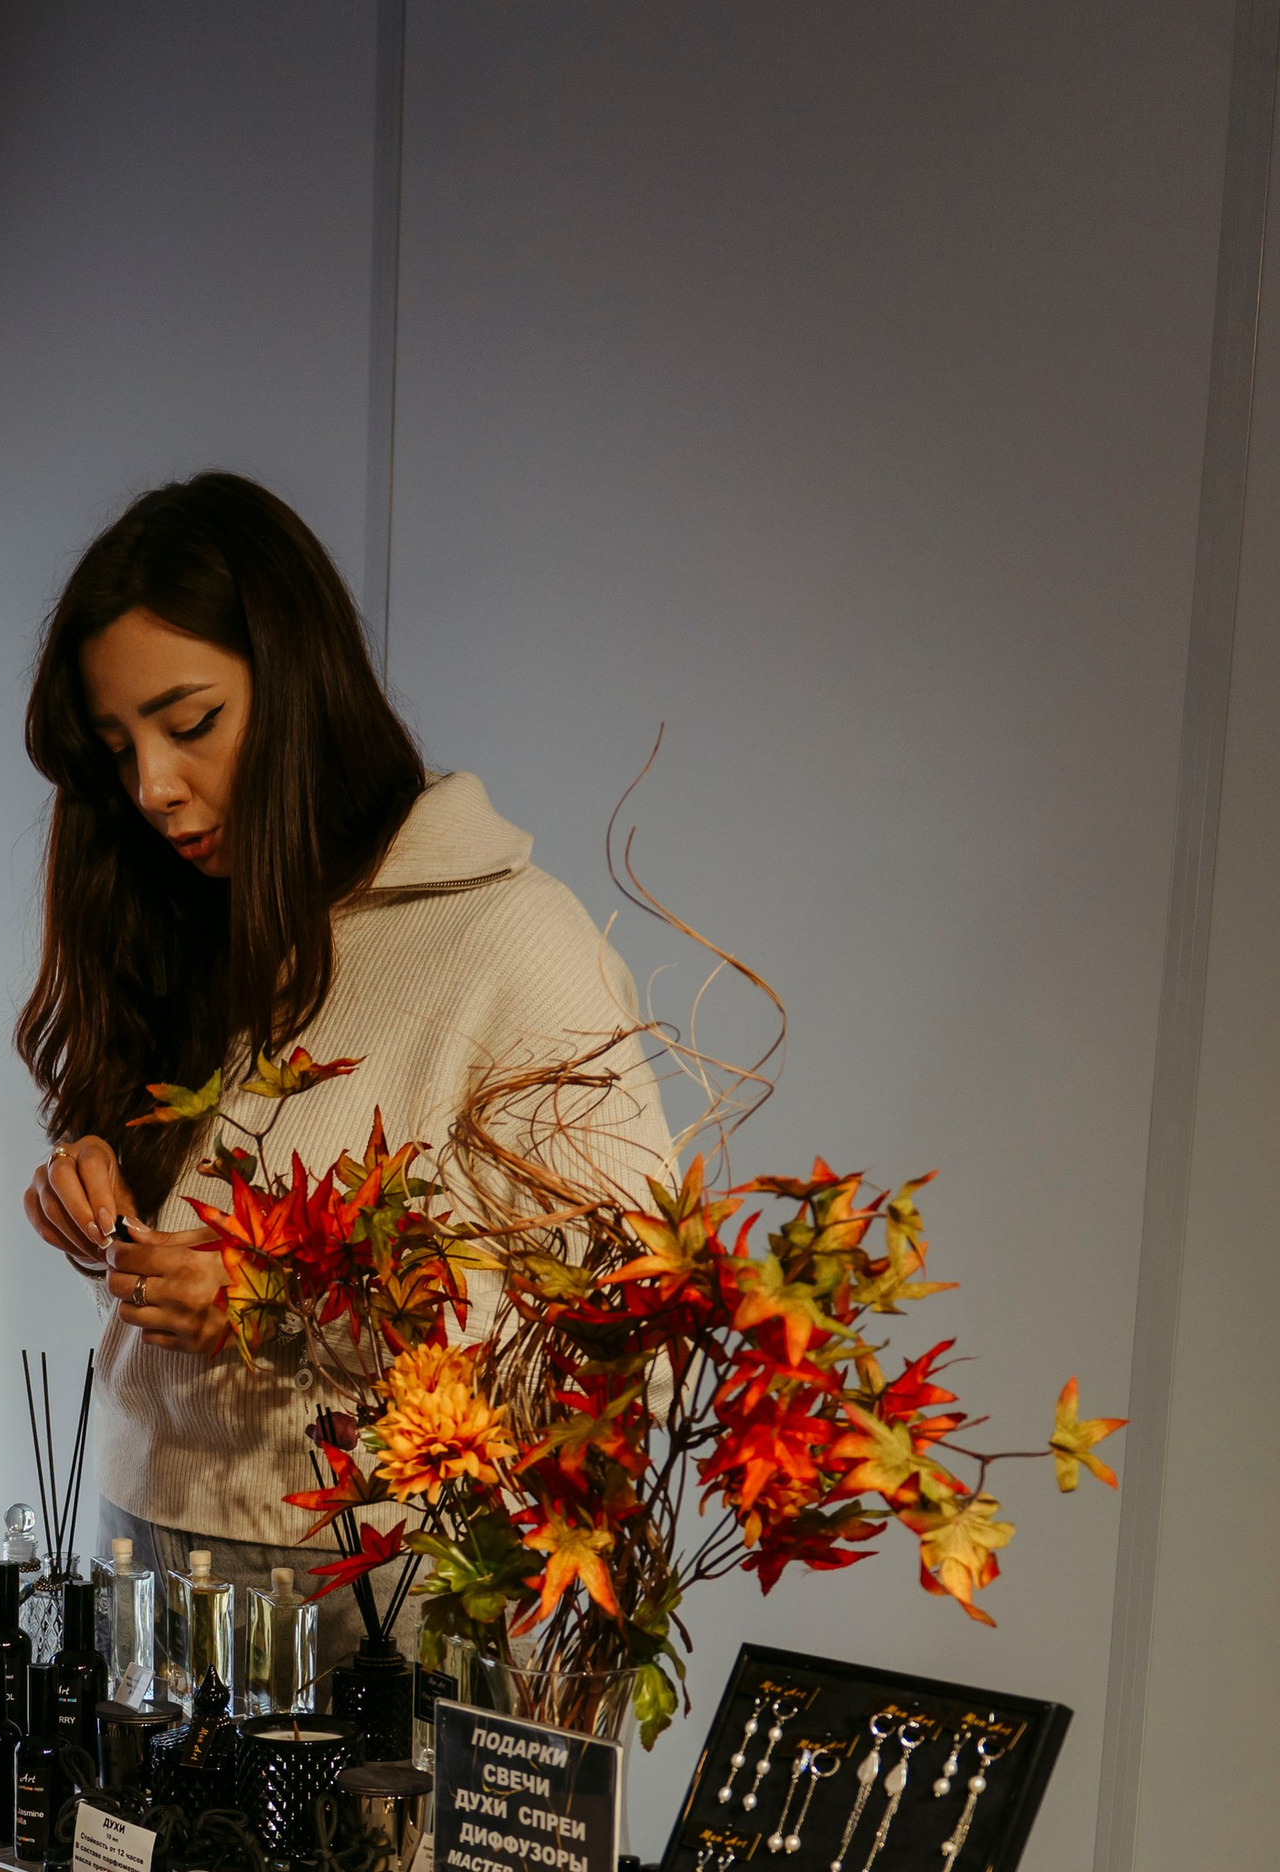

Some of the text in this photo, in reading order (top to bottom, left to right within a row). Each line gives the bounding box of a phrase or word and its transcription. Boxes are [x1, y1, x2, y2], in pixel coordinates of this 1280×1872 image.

[190, 1726, 209, 1762] Mon Art
[471, 1727, 569, 1769] ПОДАРКИ
[19, 1773, 36, 1784] Art
[482, 1763, 550, 1798] СВЕЧИ
[102, 1817, 126, 1835] ДУХИ
[454, 1788, 587, 1842] ДУХИ СПРЕИ
[74, 1854, 92, 1867] масла
[75, 1841, 80, 1849] В
[80, 1845, 102, 1860] составе
[80, 1832, 144, 1865] Стойкость от 12 часов
